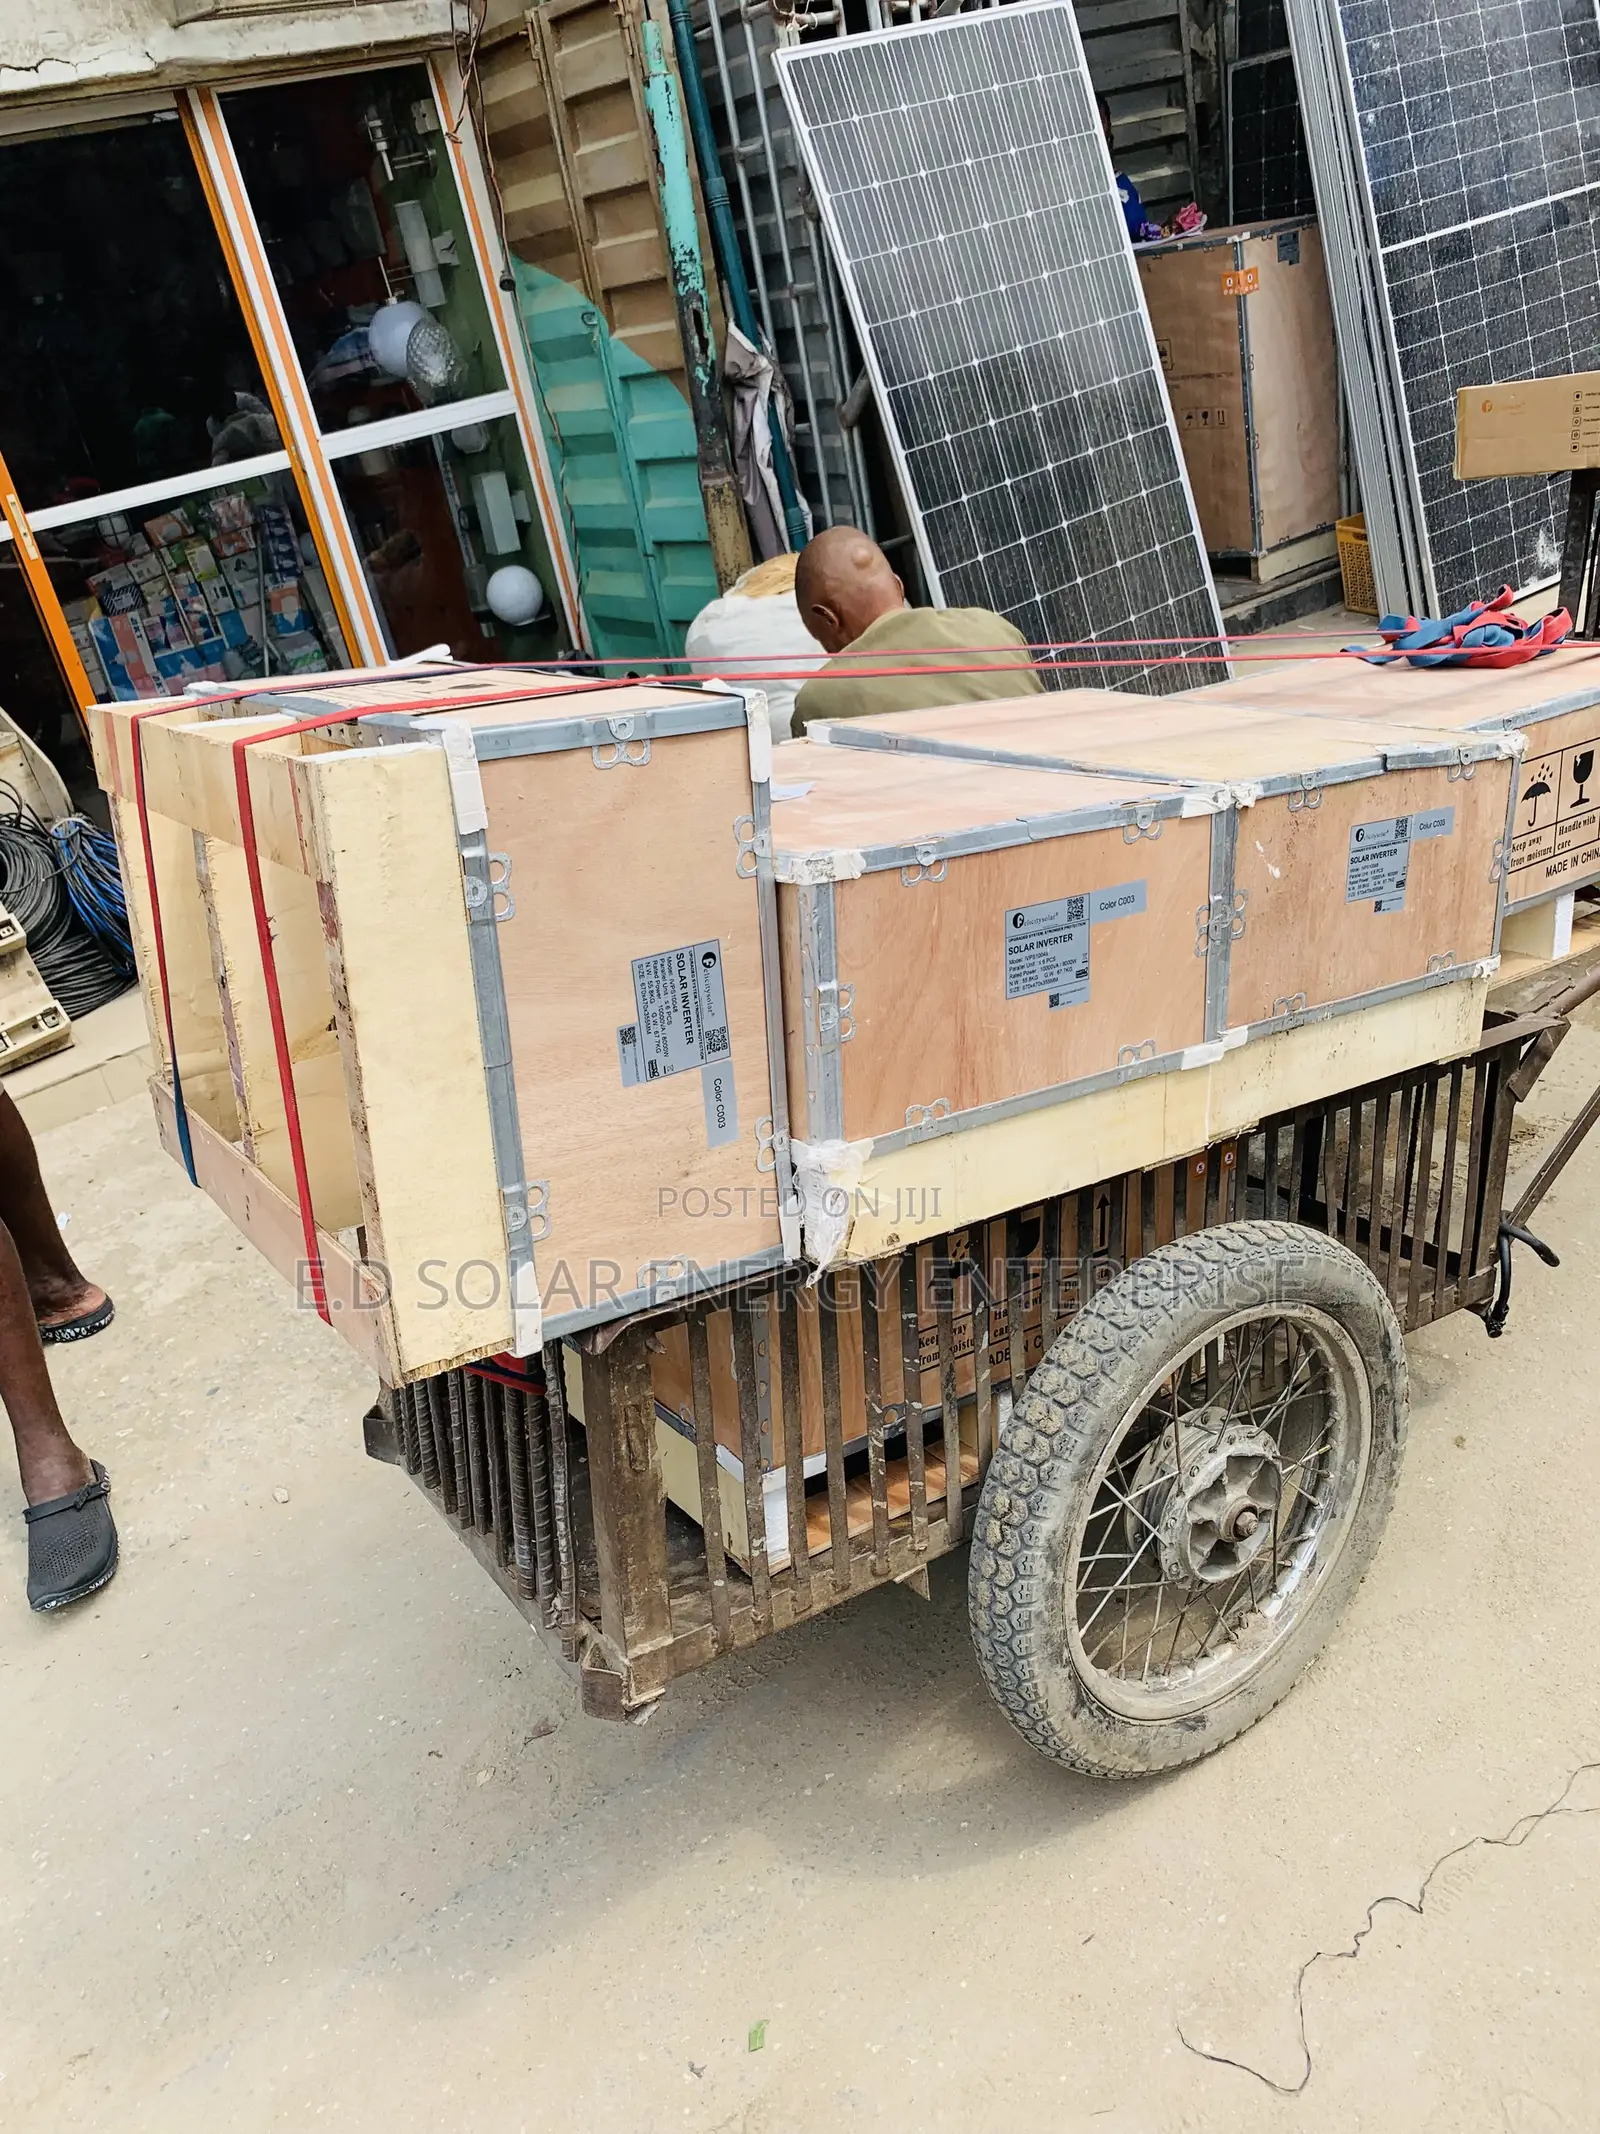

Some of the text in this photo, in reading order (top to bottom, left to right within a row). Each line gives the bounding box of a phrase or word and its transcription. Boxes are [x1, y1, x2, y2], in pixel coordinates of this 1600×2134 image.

[1559, 815, 1596, 835] Handle with
[1512, 836, 1542, 853] Keep away
[1557, 840, 1571, 850] care
[1350, 855, 1369, 864] SOLAR
[1370, 849, 1397, 860] INVERTER
[1511, 846, 1552, 867] from moisture
[1546, 847, 1600, 878] MADE IN CHIN
[1099, 895, 1135, 911] Color C003
[1008, 933, 1073, 955] SOLAR INVERTER
[676, 953, 694, 1045] SOLAR INVERTER
[713, 1078, 726, 1129] Color C003
[989, 1347, 1011, 1366] ADE
